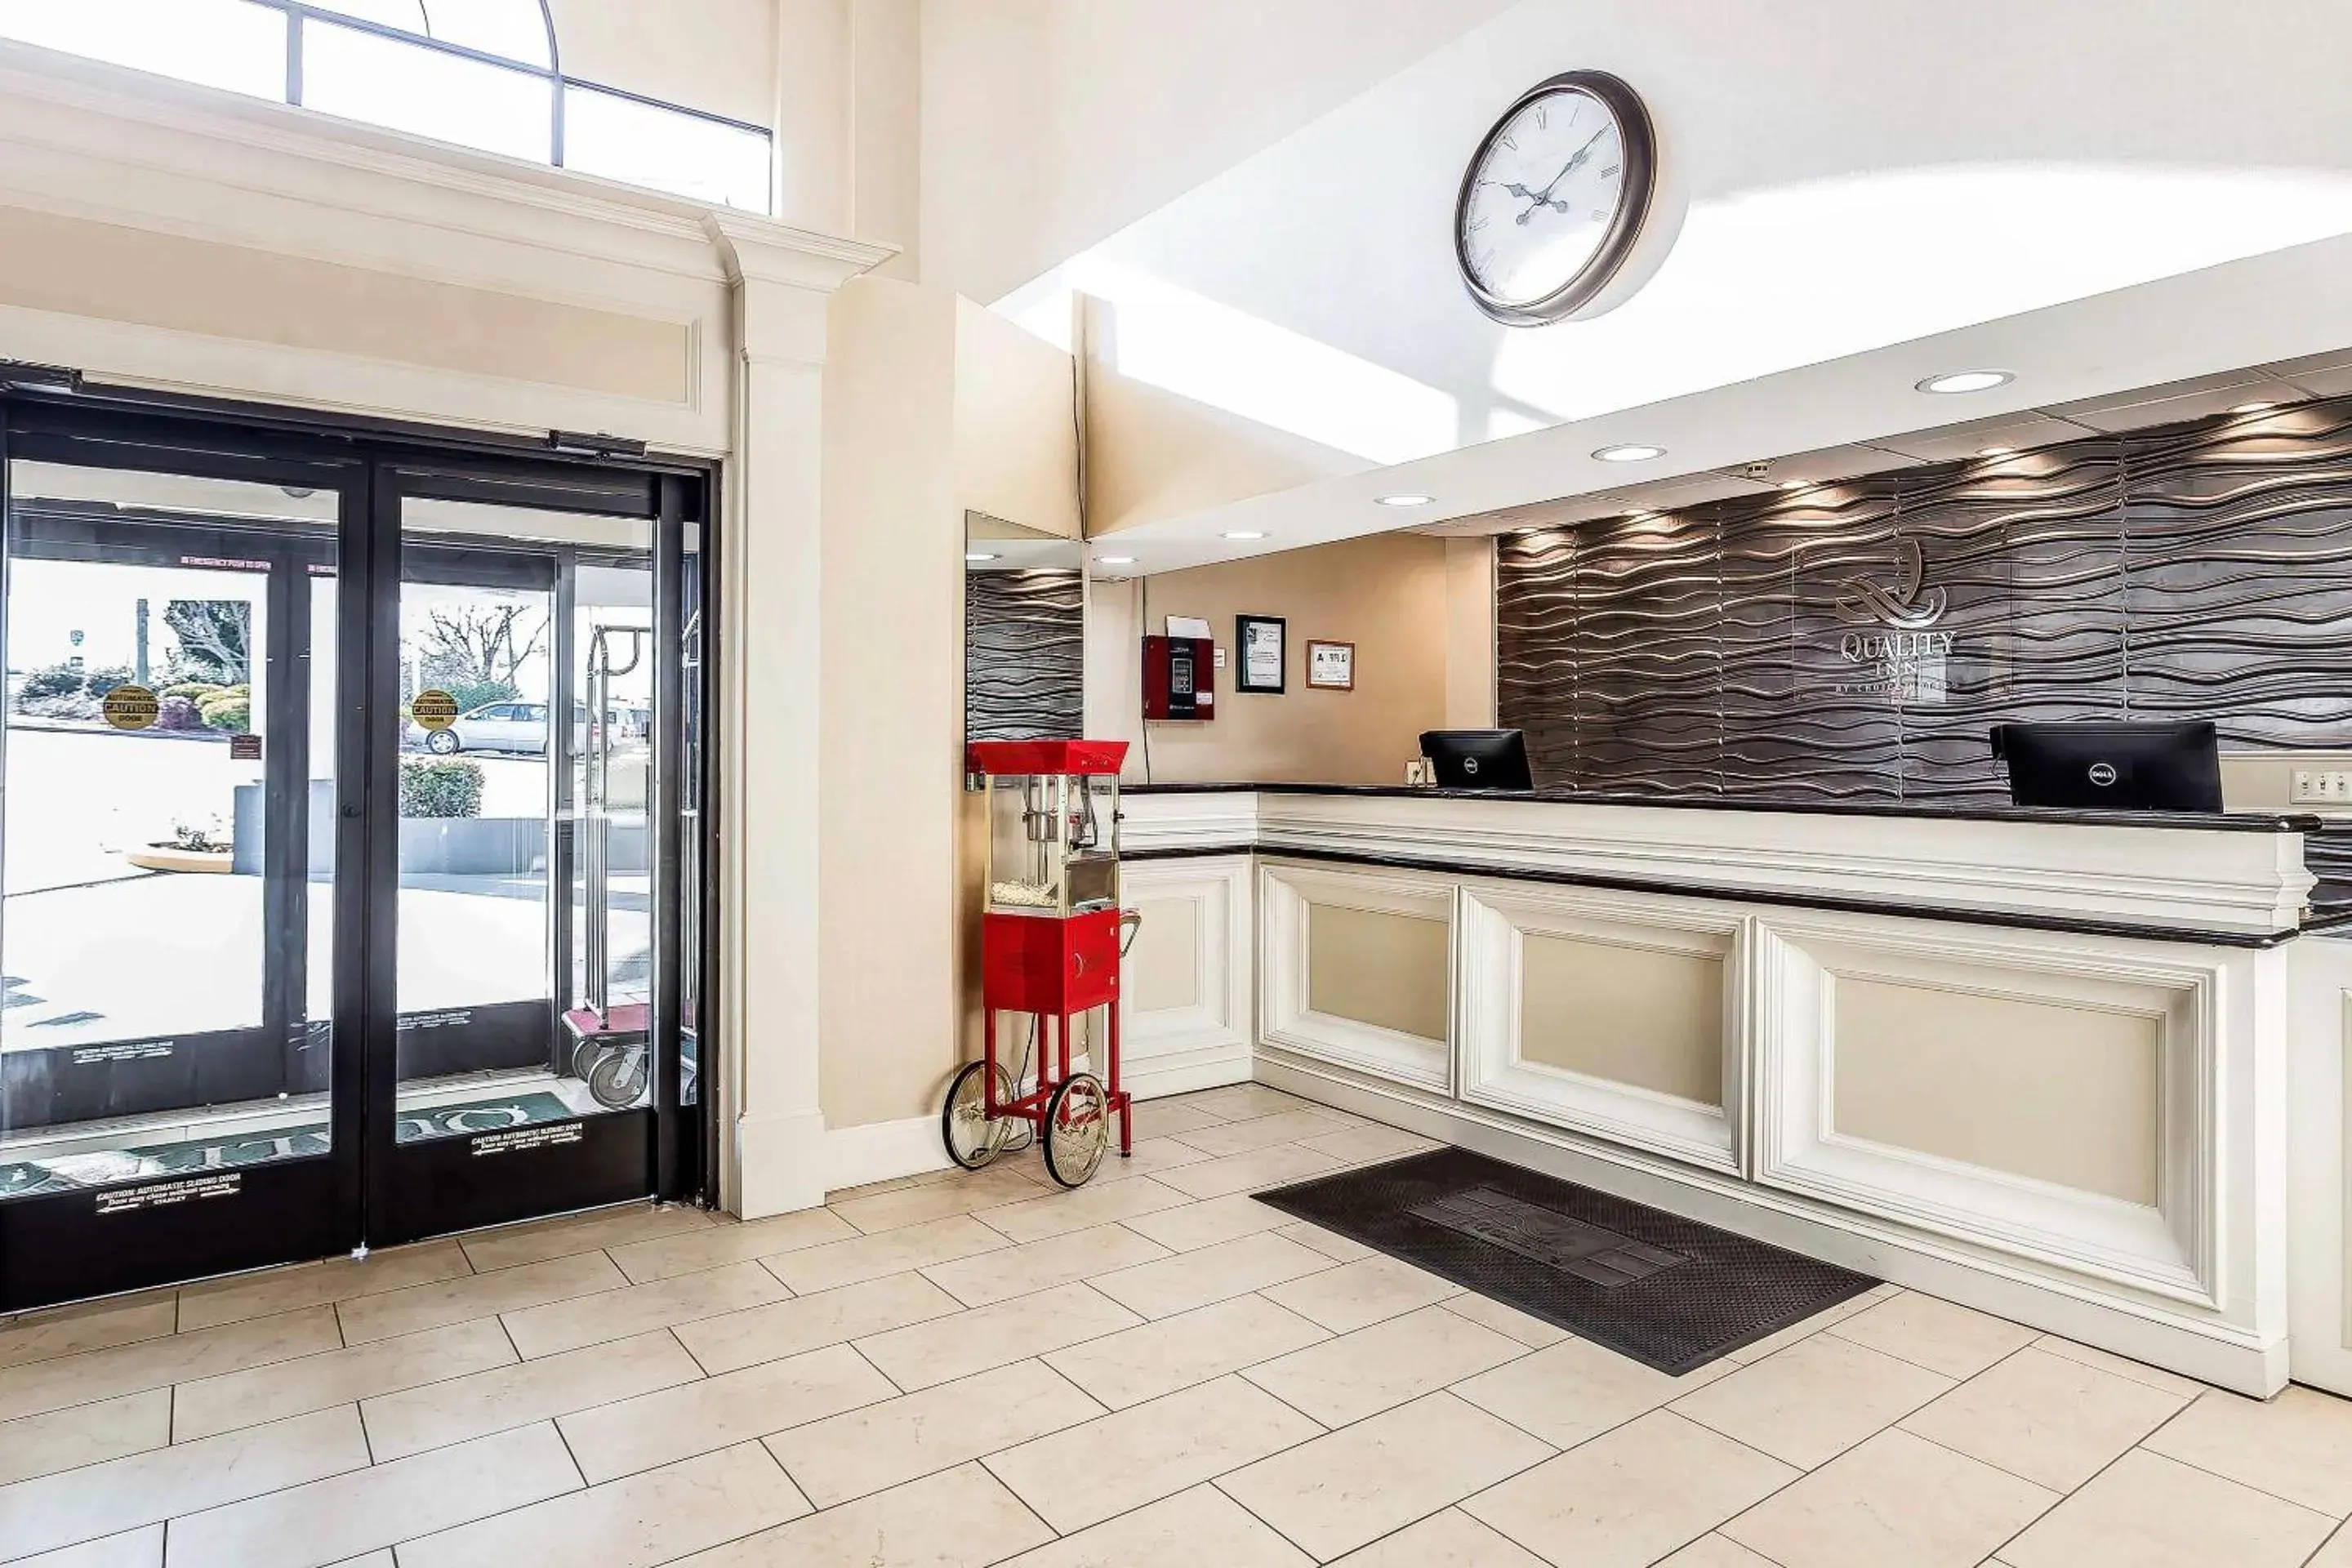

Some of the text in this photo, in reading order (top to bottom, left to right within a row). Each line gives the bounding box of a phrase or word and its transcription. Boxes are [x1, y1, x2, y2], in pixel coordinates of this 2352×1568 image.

[1840, 631, 1957, 662] QUALITY
[1875, 662, 1918, 676] INN
[104, 703, 156, 713] CAUTION
[413, 706, 456, 715] CAUTION
[137, 1183, 185, 1196] AUTOMATIC
[186, 1176, 217, 1188] SLIDING
[219, 1173, 241, 1183] DOOR
